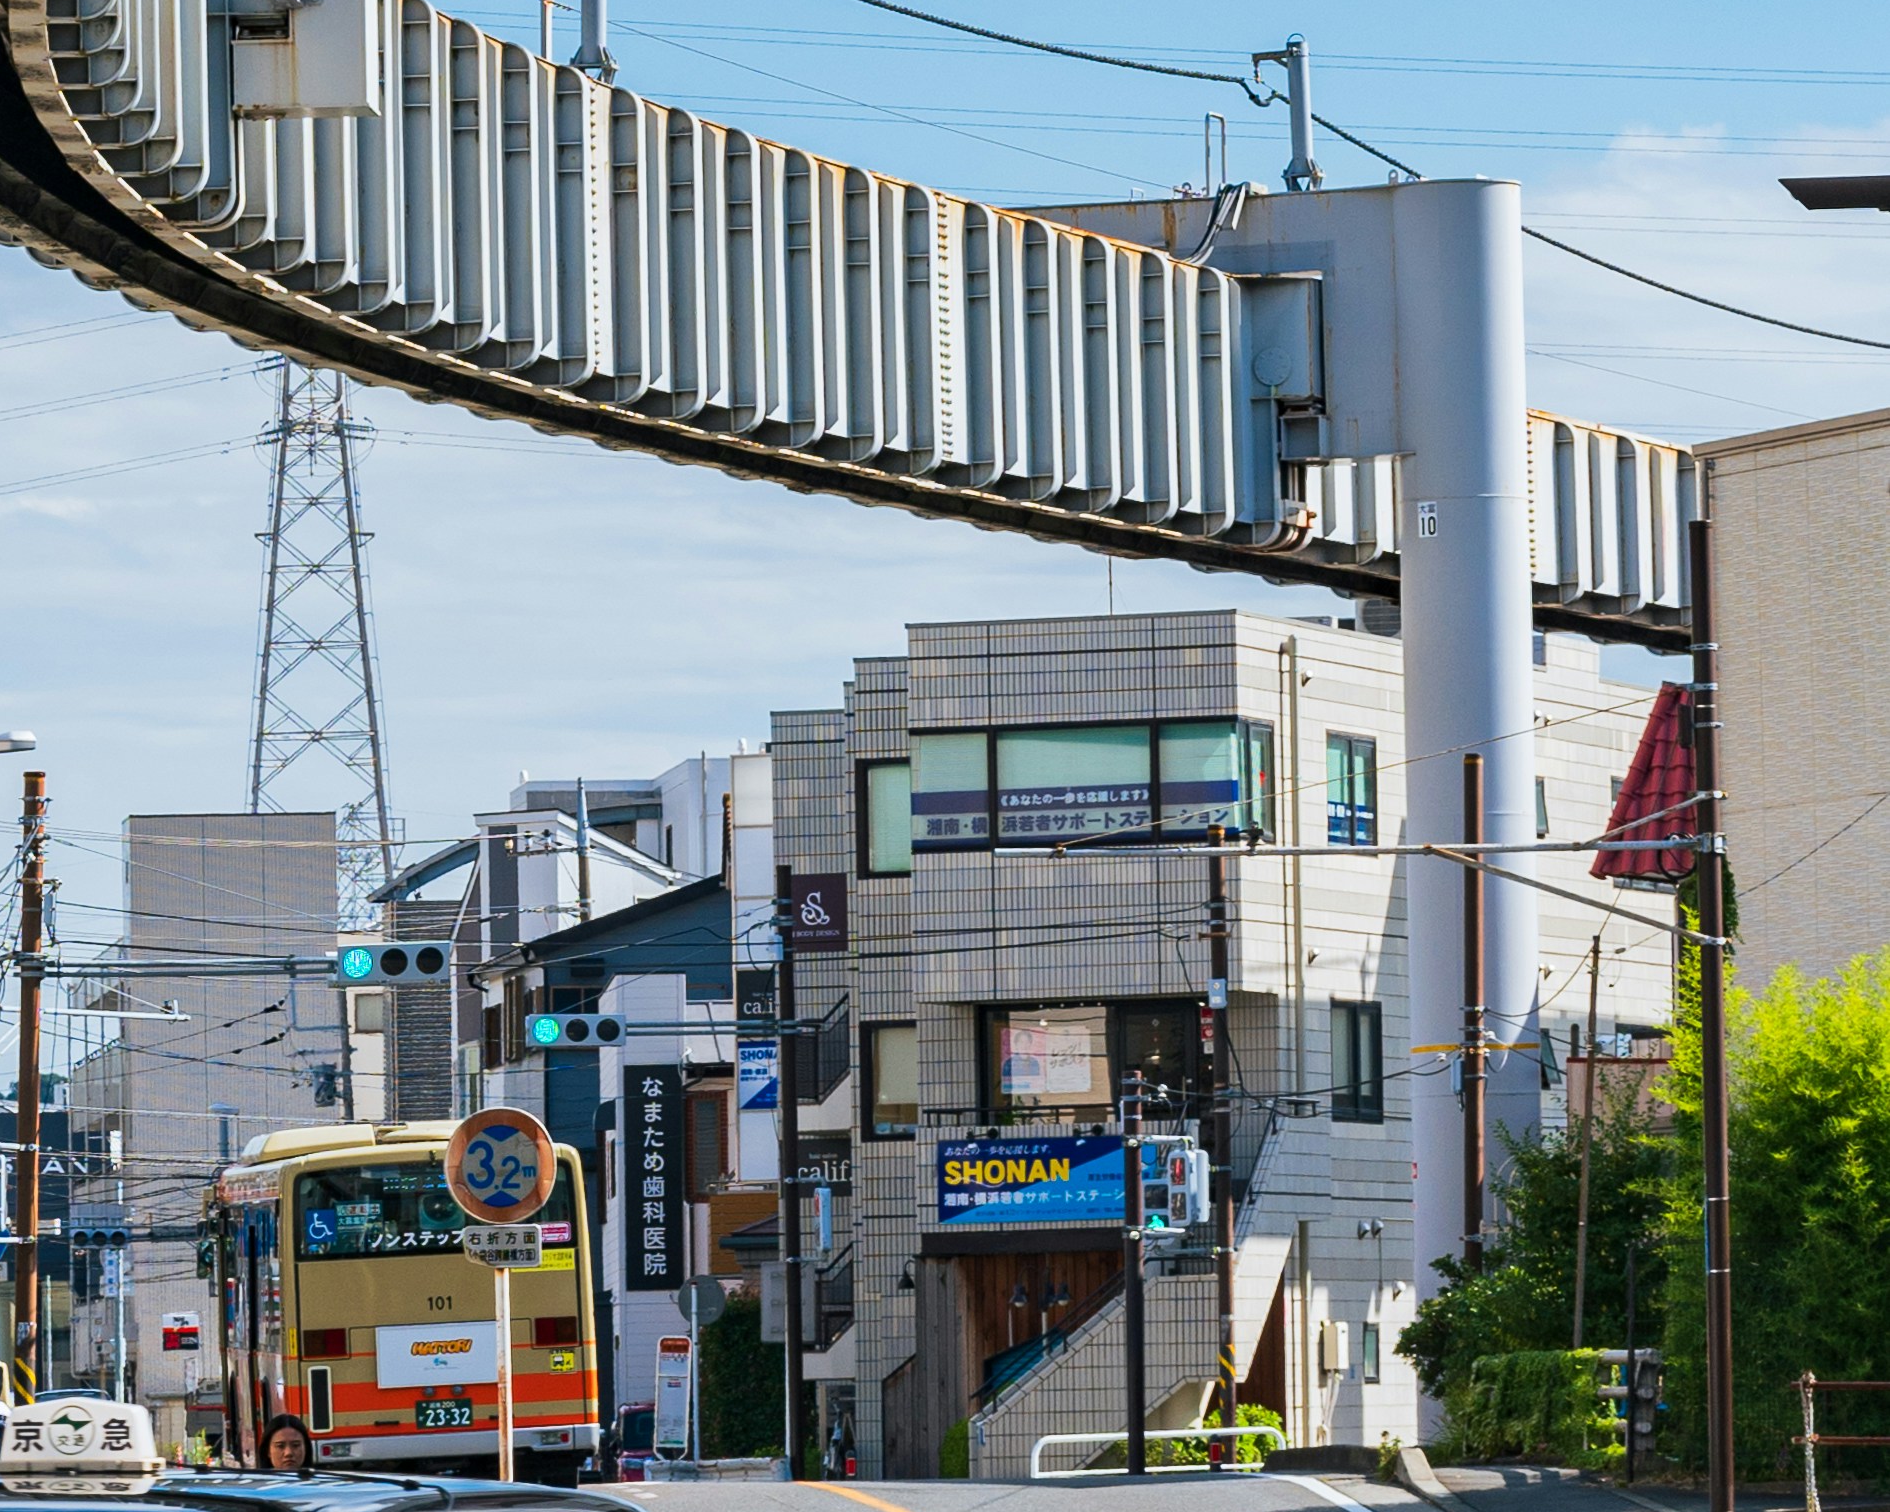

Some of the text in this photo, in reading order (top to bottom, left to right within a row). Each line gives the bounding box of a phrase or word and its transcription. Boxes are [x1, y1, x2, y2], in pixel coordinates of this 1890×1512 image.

[1421, 516, 1436, 535] 10
[740, 1048, 777, 1063] SHON
[466, 1140, 537, 1190] 3.2m
[642, 1076, 667, 1276] なまため歯科医院
[944, 1159, 1071, 1186] SHONAN
[468, 1231, 537, 1246] 右折方面
[427, 1296, 453, 1310] 101
[12, 1418, 132, 1452] 京 急
